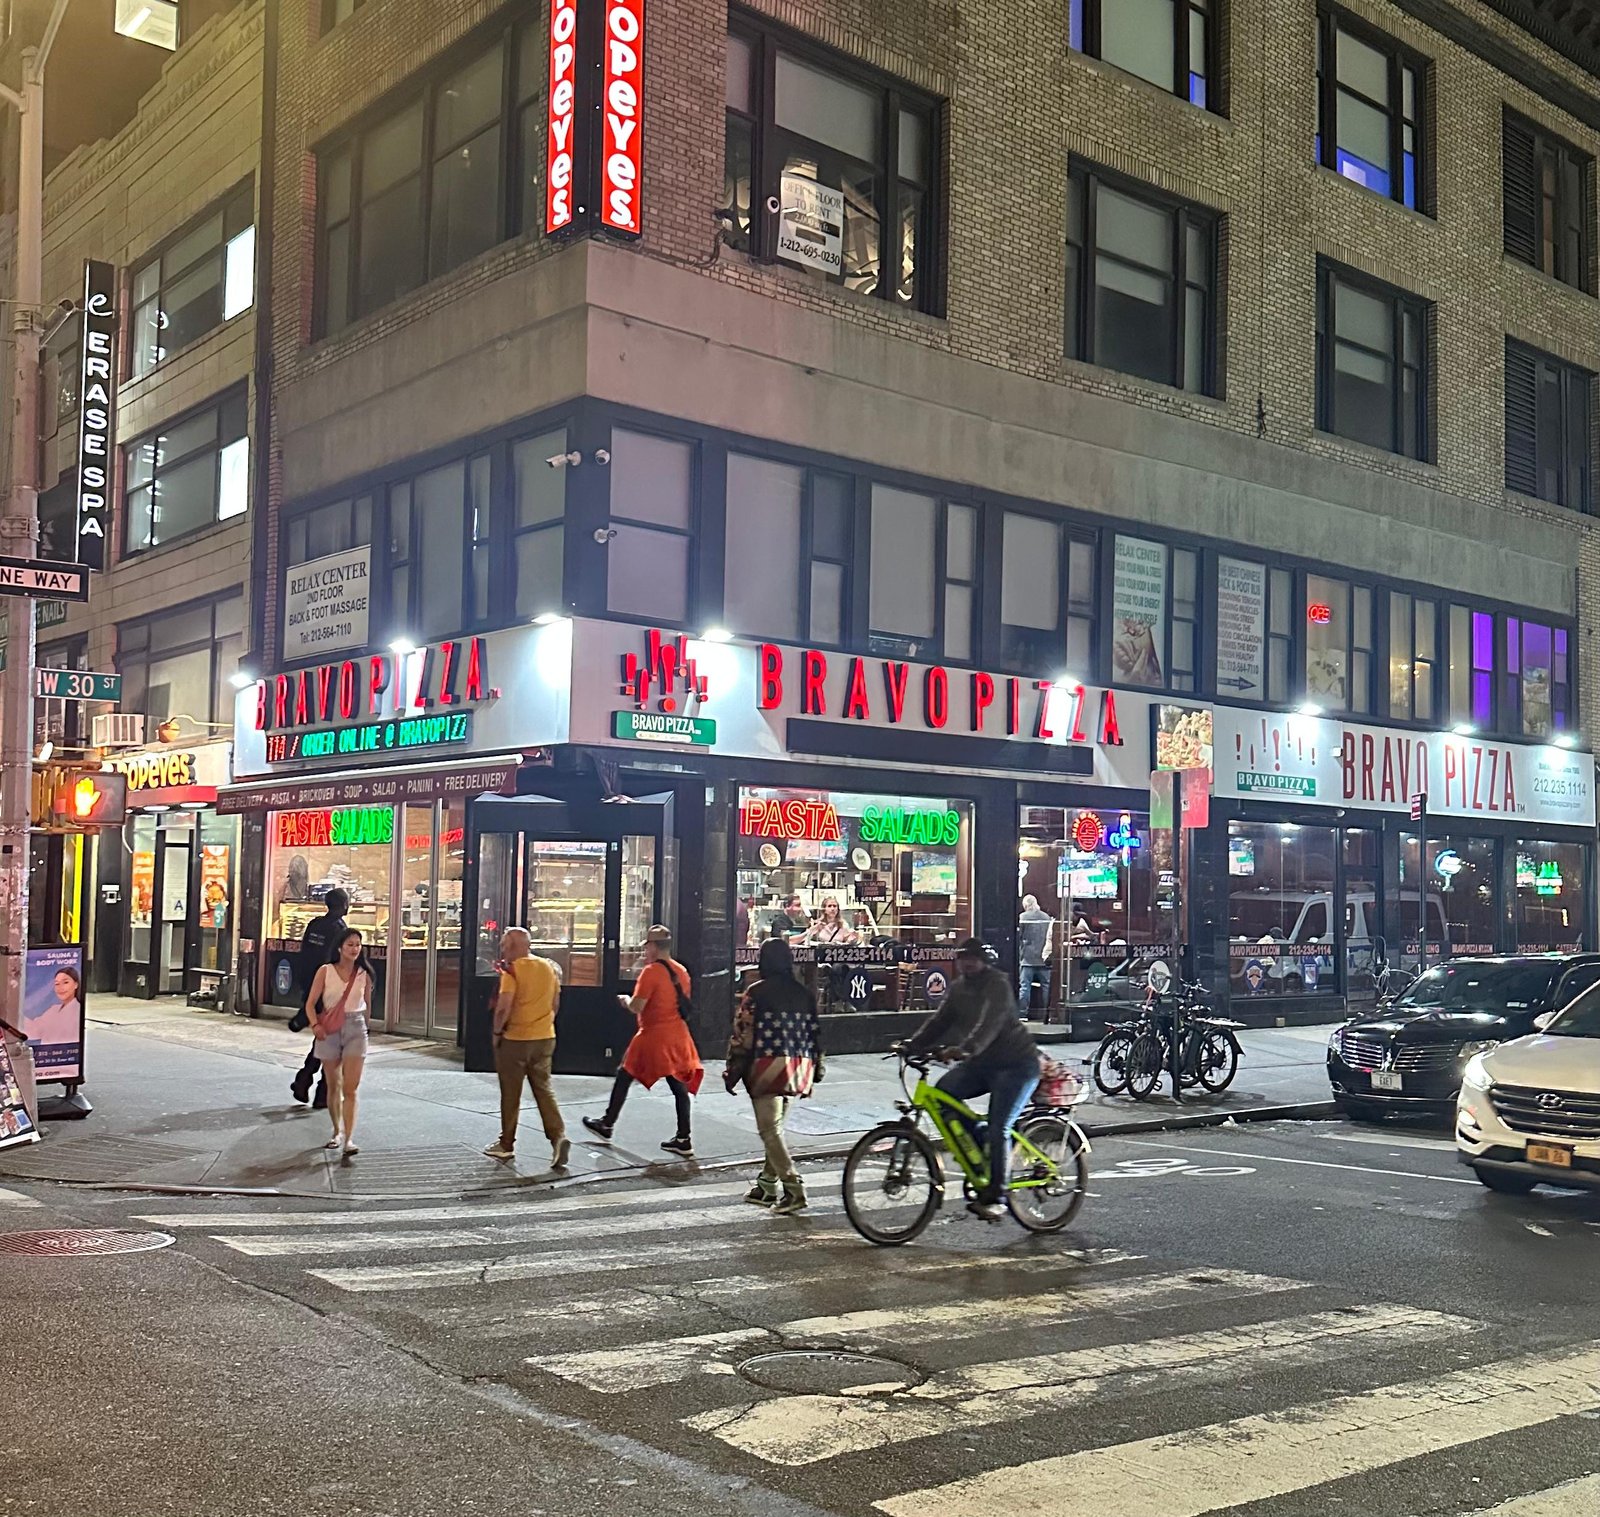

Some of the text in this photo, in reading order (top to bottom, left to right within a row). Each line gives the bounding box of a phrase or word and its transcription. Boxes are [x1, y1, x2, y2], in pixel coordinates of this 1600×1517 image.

[551, 0, 575, 226] opeyes
[606, 0, 639, 228] opeyes
[795, 198, 806, 210] TO
[780, 237, 840, 266] 1-212-695-0230
[80, 331, 110, 538] ERASE SPA
[1136, 547, 1161, 563] CENTER
[0, 569, 72, 590] NE WAY
[291, 561, 367, 595] RELAX CENTER
[307, 585, 343, 605] 2ND FLOOR
[42, 601, 65, 623] NAILS
[289, 597, 367, 626] BACK & FOOT MASSAGE
[311, 622, 352, 641] 212-564-7110
[43, 672, 116, 698] W 30 ST
[255, 660, 354, 731] BRAVO
[369, 637, 482, 715] PIZZA
[761, 643, 1120, 746] BRAVO PIZZA
[37, 721, 64, 734] SON
[632, 714, 695, 734] BRAVO PIZZA
[302, 731, 335, 757] ORDER
[339, 725, 381, 753] ONLINE
[399, 714, 467, 746] BRAVOPIZZ
[1238, 773, 1276, 787] BRAVO
[1277, 776, 1310, 791] PIZZA
[1343, 731, 1428, 803] BRAVO
[1445, 744, 1516, 812] PIZZA
[270, 792, 290, 805] PASTA
[298, 787, 335, 802] BRICKOVEN
[344, 784, 362, 798] SOUP
[372, 781, 396, 796] SALAD
[407, 778, 433, 793] PANINI
[444, 775, 465, 790] FREE
[466, 772, 507, 789] DELIVERY
[278, 811, 329, 846] PASTA
[330, 806, 393, 845] SALADS
[744, 797, 960, 846] PASTA SALADS
[174, 900, 184, 911] A
[47, 951, 72, 959] SAUNA
[792, 949, 815, 962] Y.COM
[824, 948, 894, 962] 212-235-1114
[1133, 946, 1185, 958] 212-235-14
[1288, 945, 1332, 956] 212-235-1114
[1406, 944, 1440, 954] CATING
[851, 974, 867, 998] NY
[1087, 975, 1107, 984] JETS
